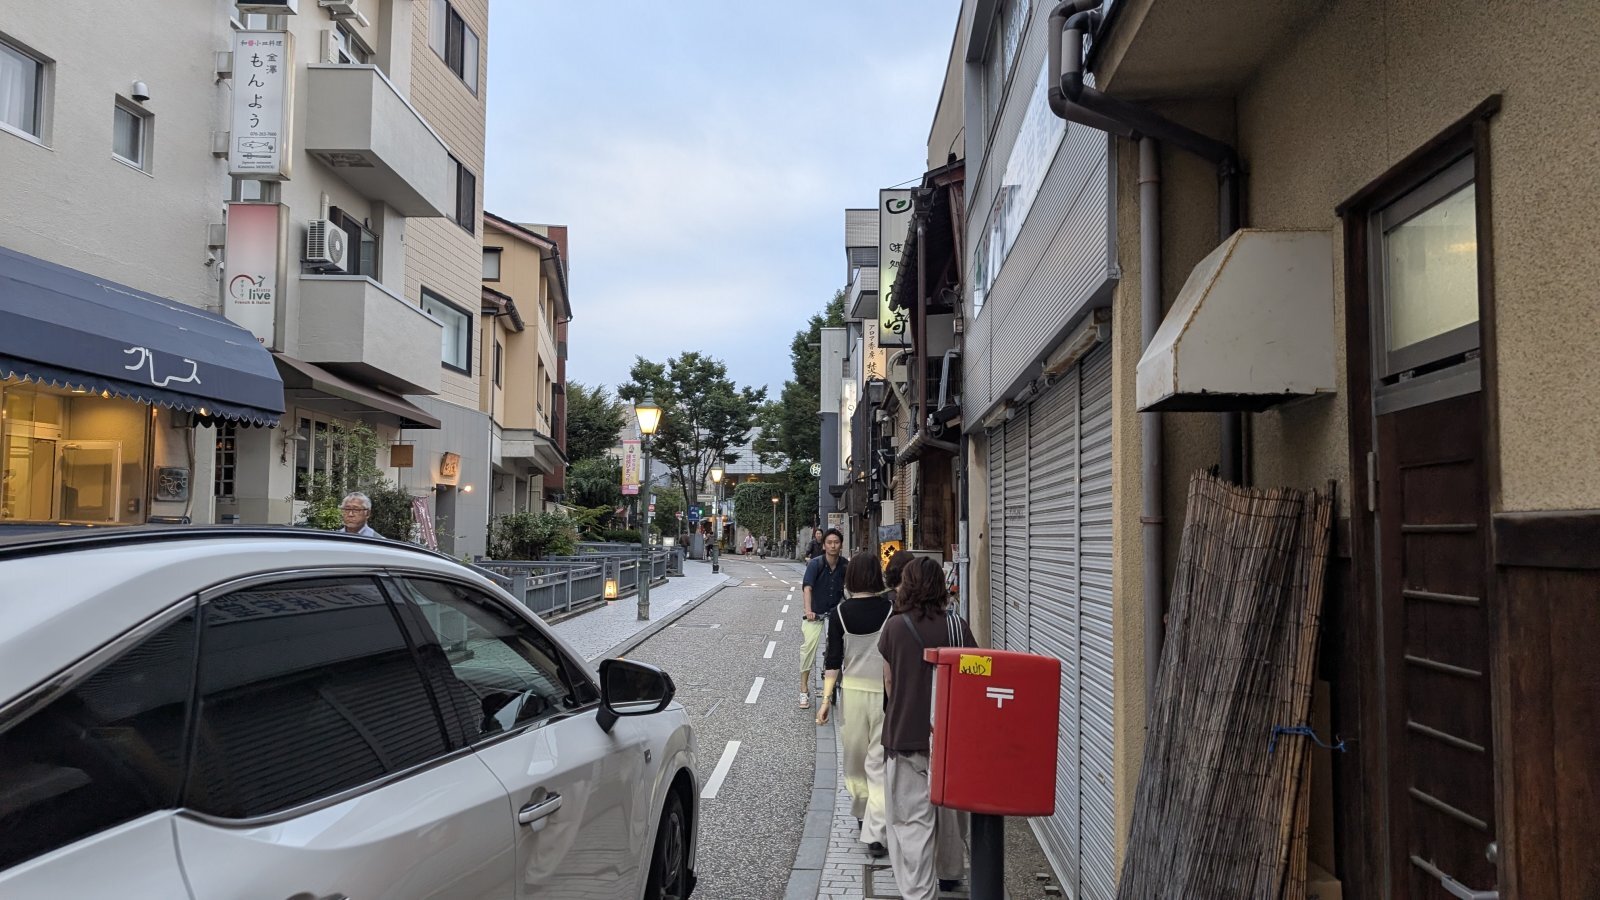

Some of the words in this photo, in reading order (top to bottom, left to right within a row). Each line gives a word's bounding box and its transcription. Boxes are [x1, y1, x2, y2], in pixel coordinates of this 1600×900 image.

[265, 53, 278, 74] 金澤
[247, 53, 264, 128] もんよう
